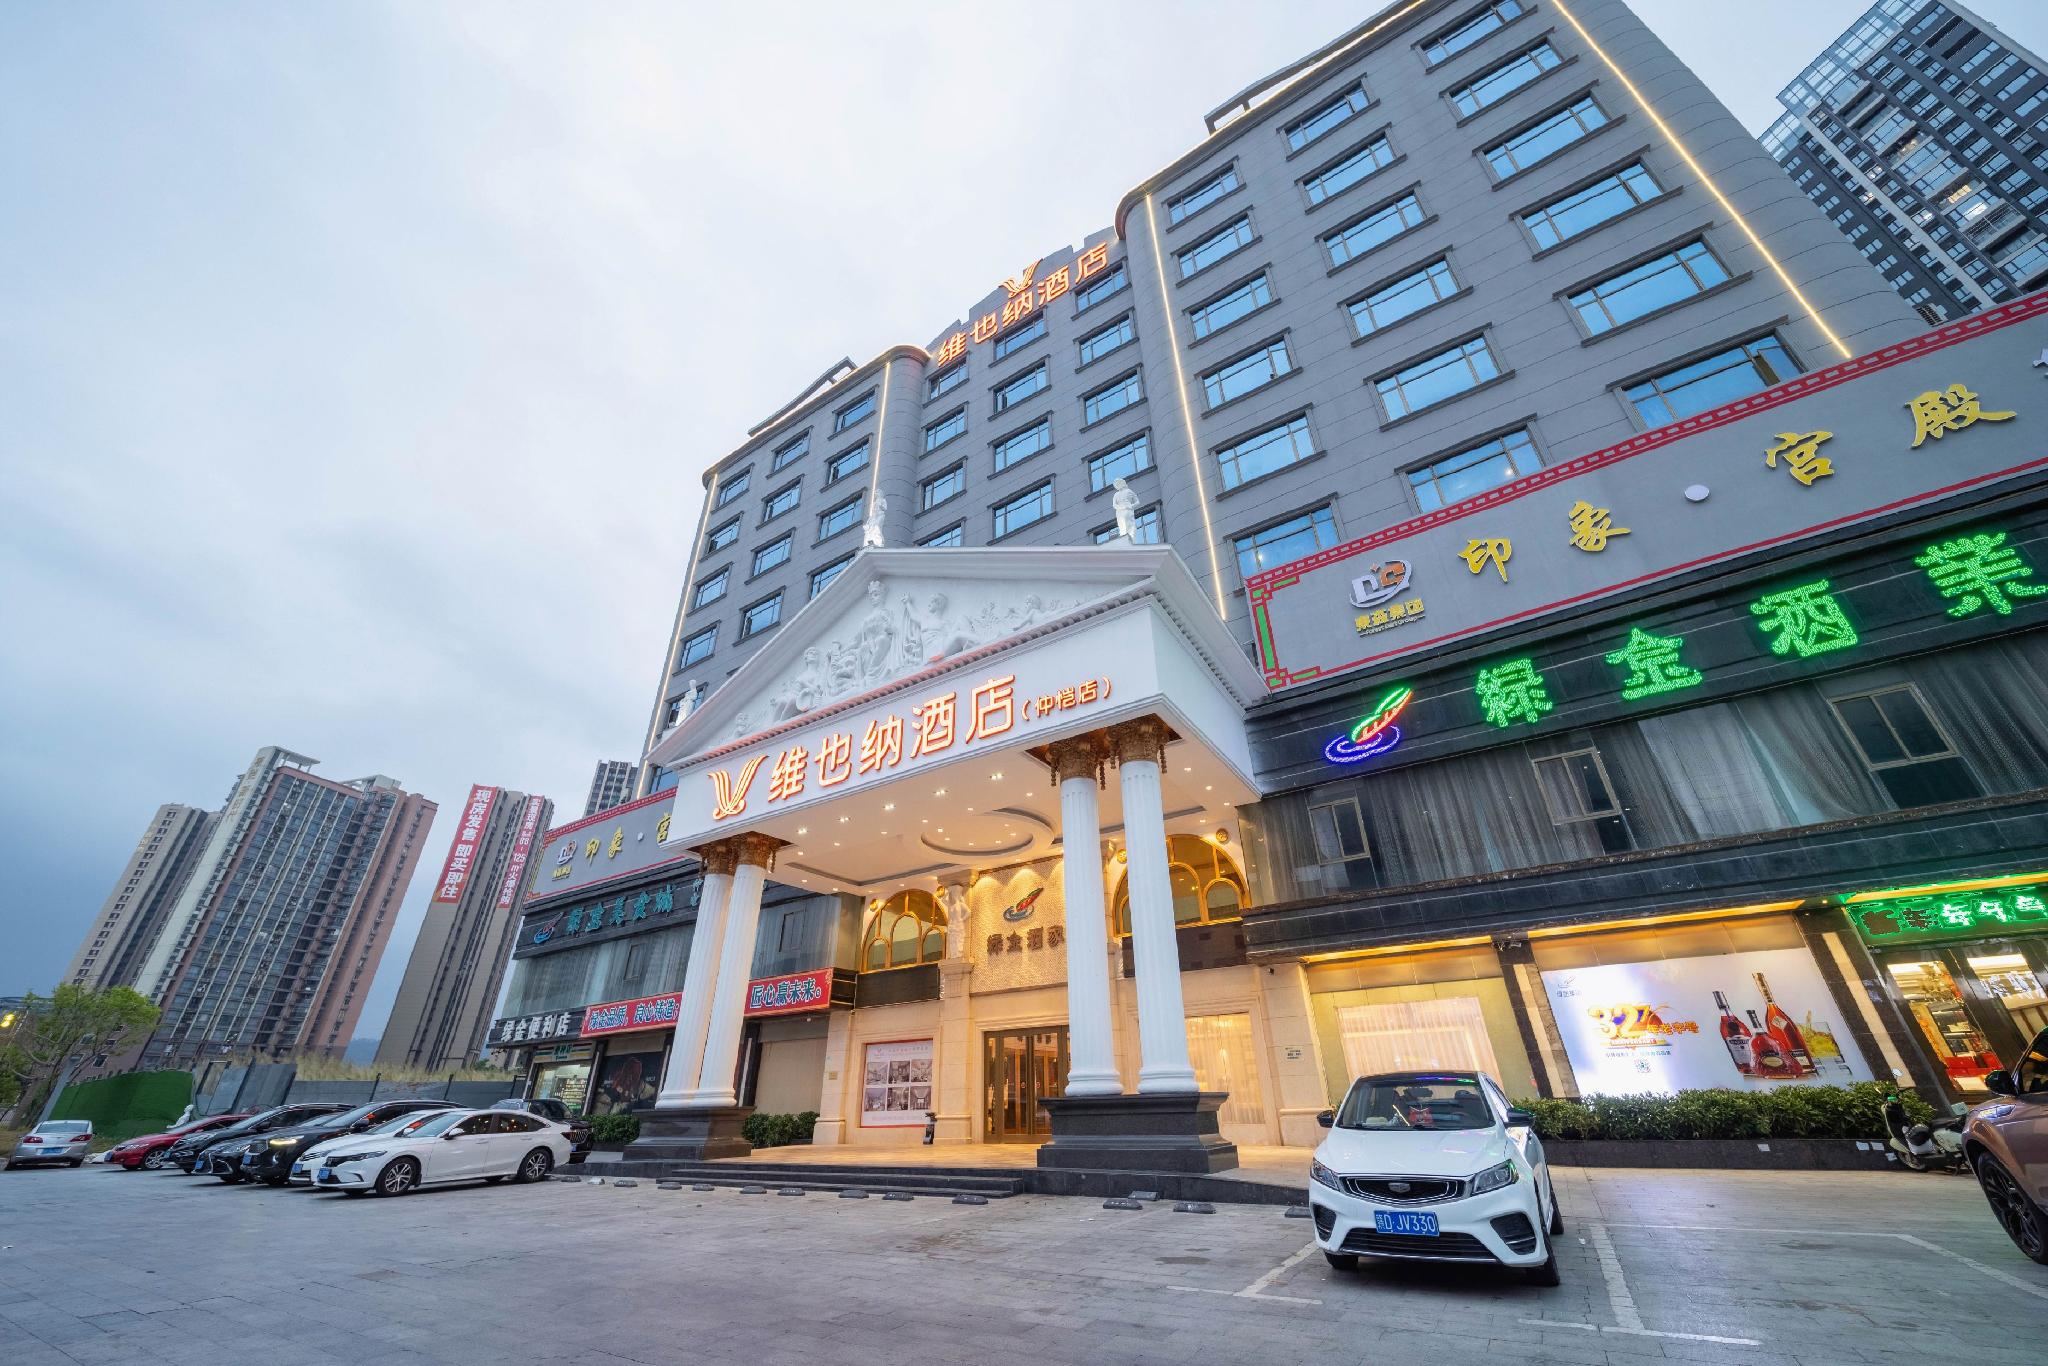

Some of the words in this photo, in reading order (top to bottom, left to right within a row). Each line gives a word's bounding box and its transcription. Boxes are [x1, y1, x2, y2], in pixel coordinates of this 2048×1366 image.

[938, 242, 1109, 367] 维也纳酒店
[767, 674, 1016, 803] 维也纳酒店
[461, 789, 493, 842] 现房发售
[440, 843, 473, 899] 即买即住
